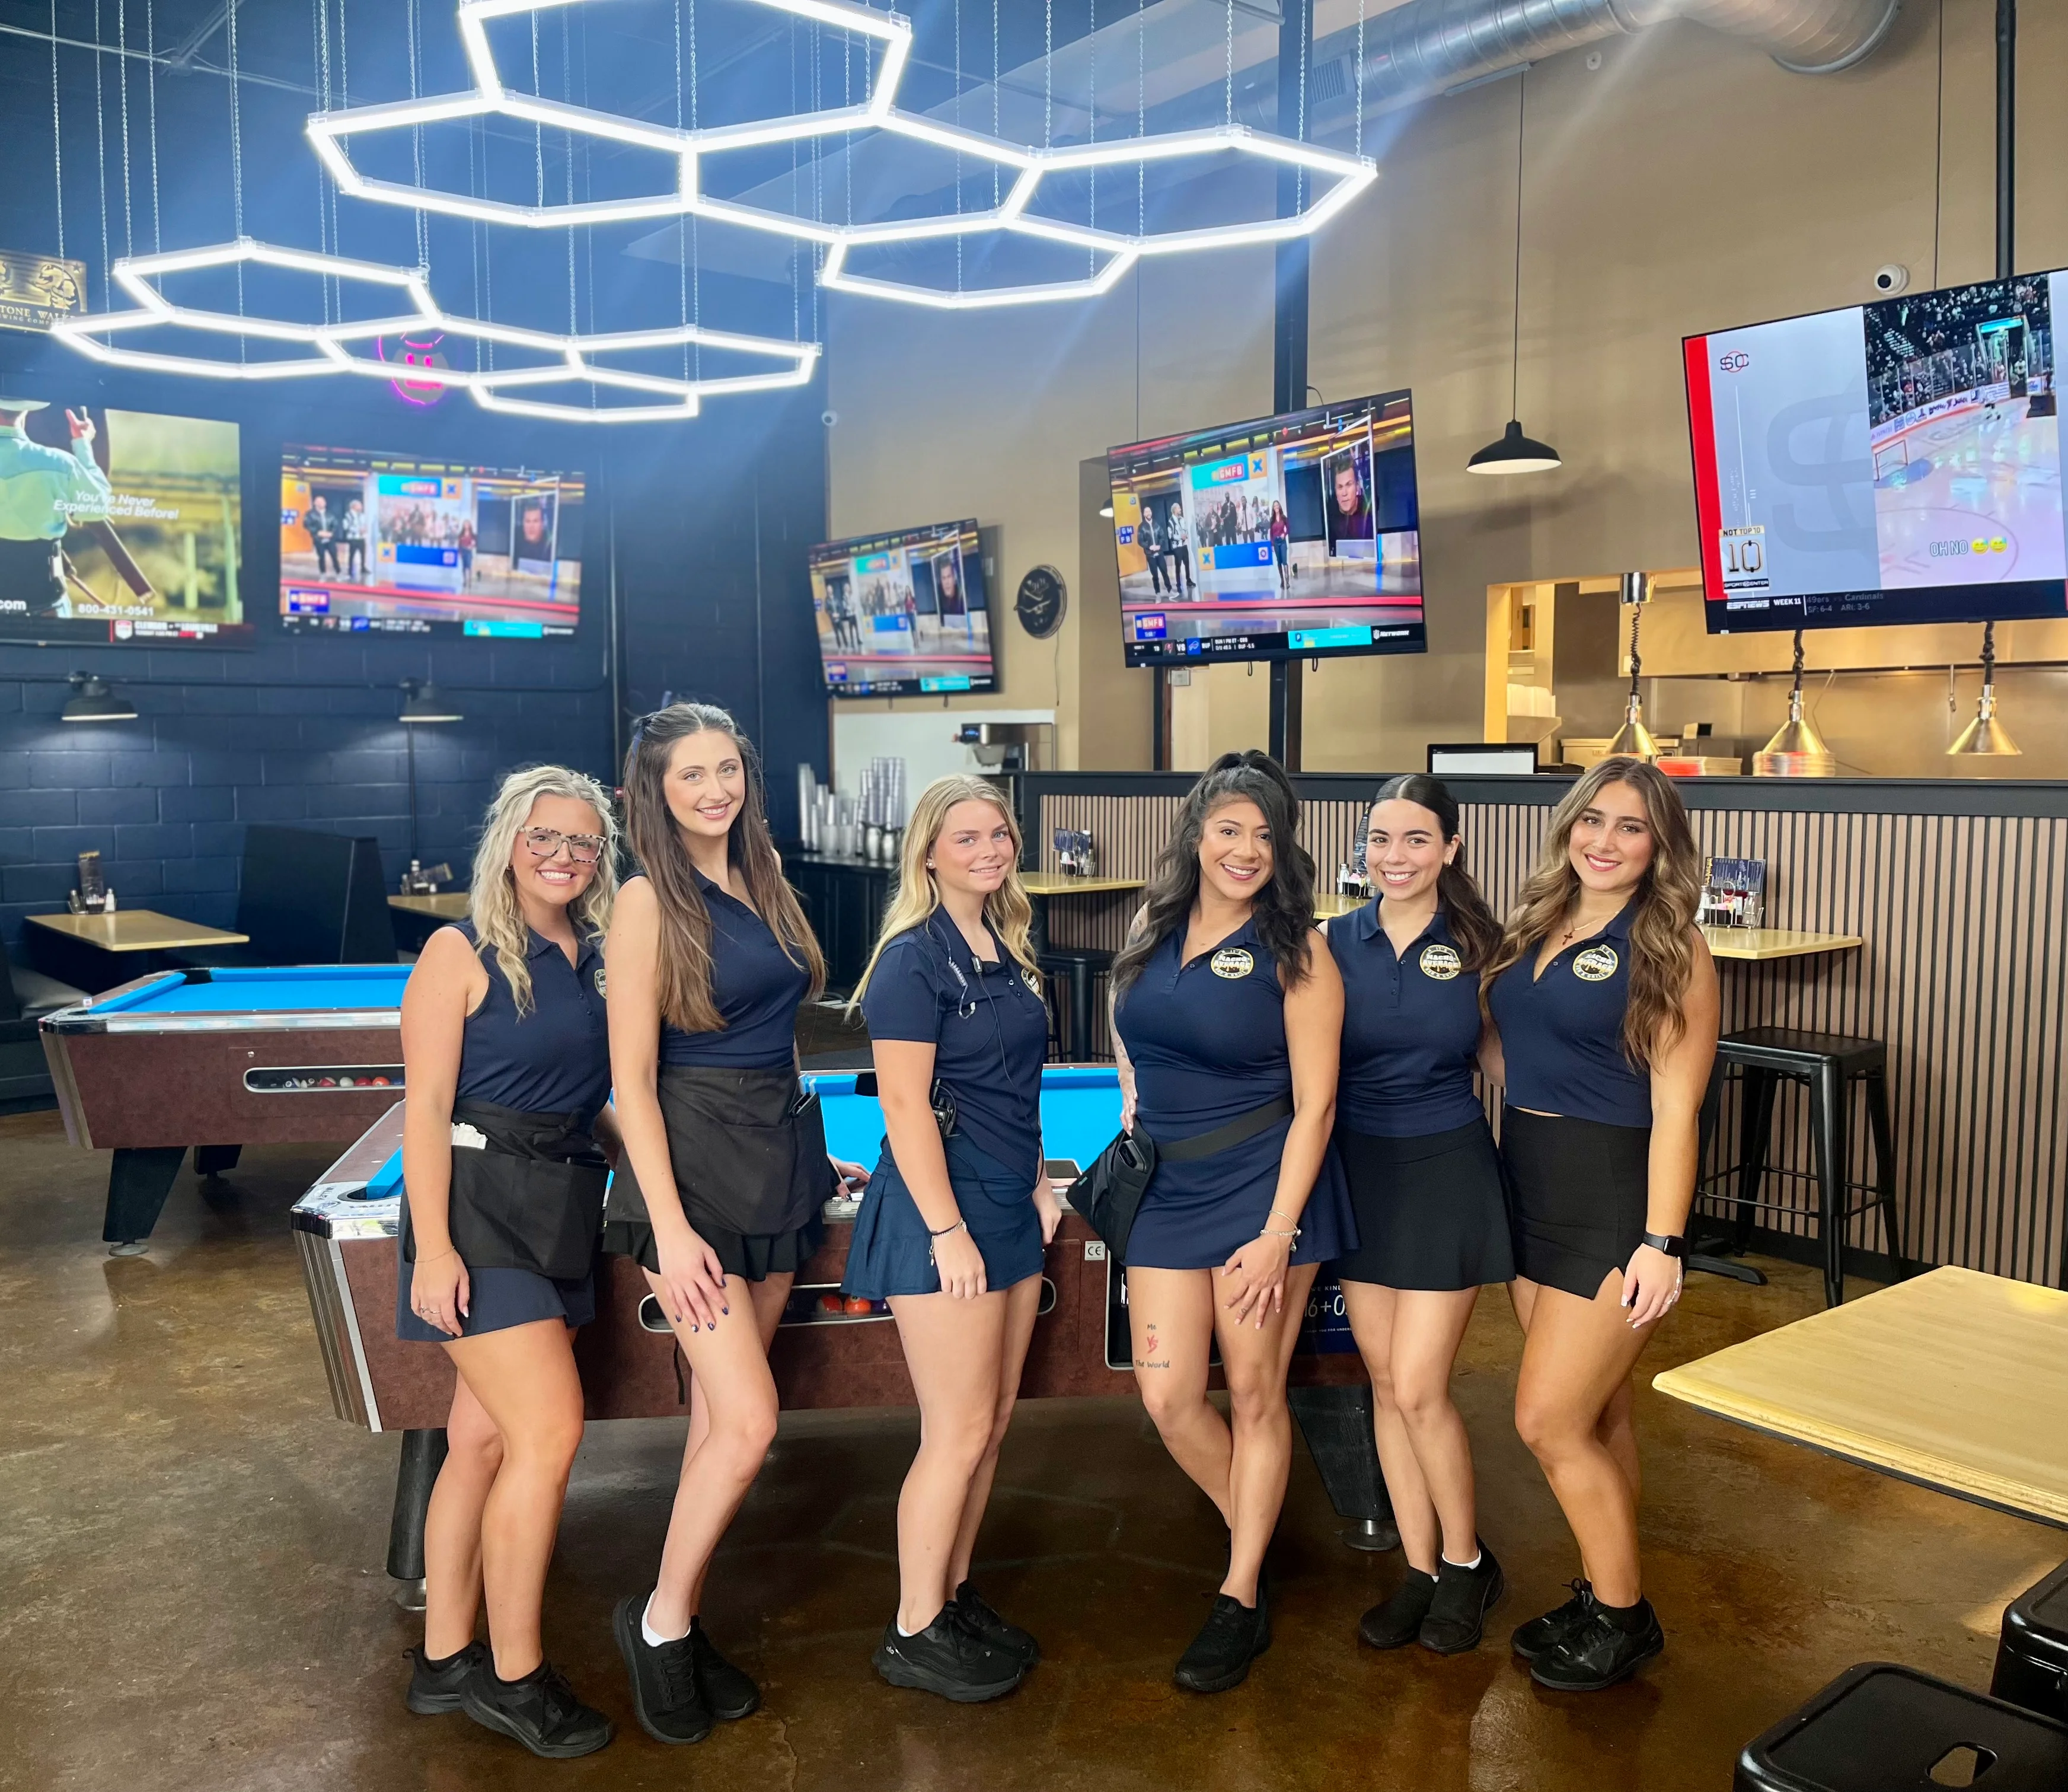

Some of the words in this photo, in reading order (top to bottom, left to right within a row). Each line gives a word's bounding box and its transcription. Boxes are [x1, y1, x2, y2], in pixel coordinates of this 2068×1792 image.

[1720, 353, 1750, 371] SC
[1219, 464, 1243, 479] GMFB
[119, 494, 155, 506] Never
[53, 499, 132, 515] Experienced
[135, 506, 179, 519] Before!
[1930, 541, 1948, 557] OH
[1950, 539, 1968, 555] NO
[1728, 540, 1761, 573] 10
[1807, 595, 1830, 603] 49ers
[1844, 592, 1884, 601] Cardinals
[78, 604, 154, 616] 800-431-0541
[1858, 602, 1871, 610] 3-6
[1142, 617, 1163, 629] GMFB
[1218, 954, 1247, 962] NACHO
[1426, 954, 1454, 962] NACHO
[1214, 959, 1251, 970] AVERAGE
[1422, 959, 1459, 970] AVERAGE
[1088, 1246, 1101, 1257] CE
